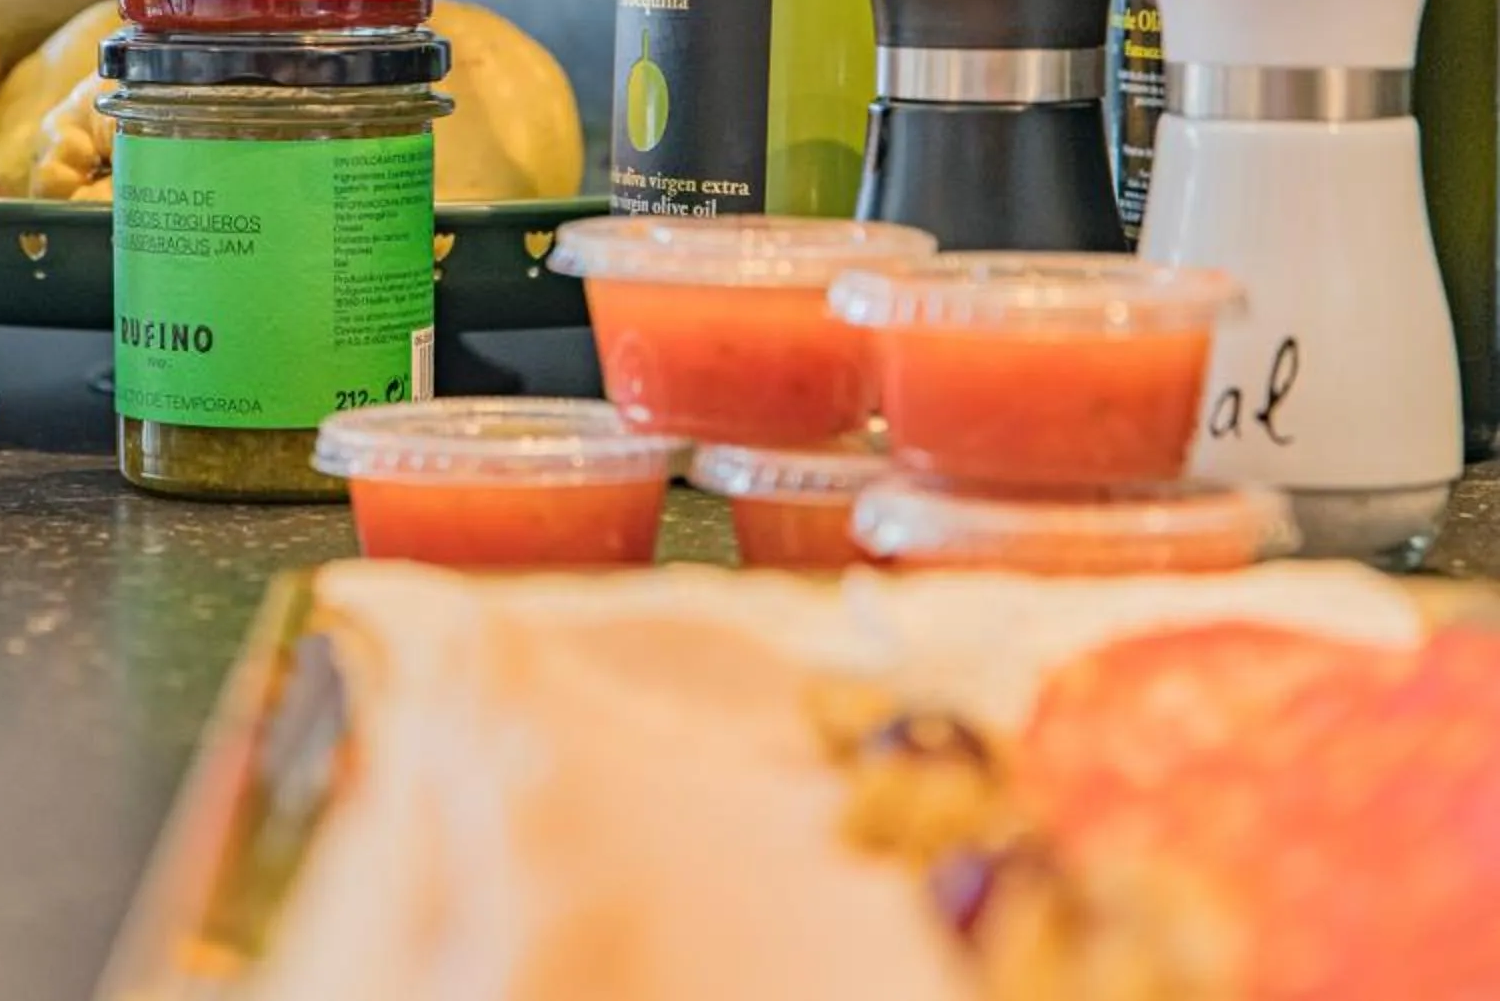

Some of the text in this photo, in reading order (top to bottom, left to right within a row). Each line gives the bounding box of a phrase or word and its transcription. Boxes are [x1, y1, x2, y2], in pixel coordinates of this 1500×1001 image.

[649, 170, 697, 198] virgen
[701, 179, 751, 196] extra
[193, 189, 217, 208] DE
[651, 195, 689, 216] olive
[693, 198, 717, 219] oil
[163, 212, 262, 234] TRIGUEROS
[214, 239, 256, 258] JAM
[120, 316, 214, 354] RUFINO
[164, 393, 263, 416] TEMPORADA
